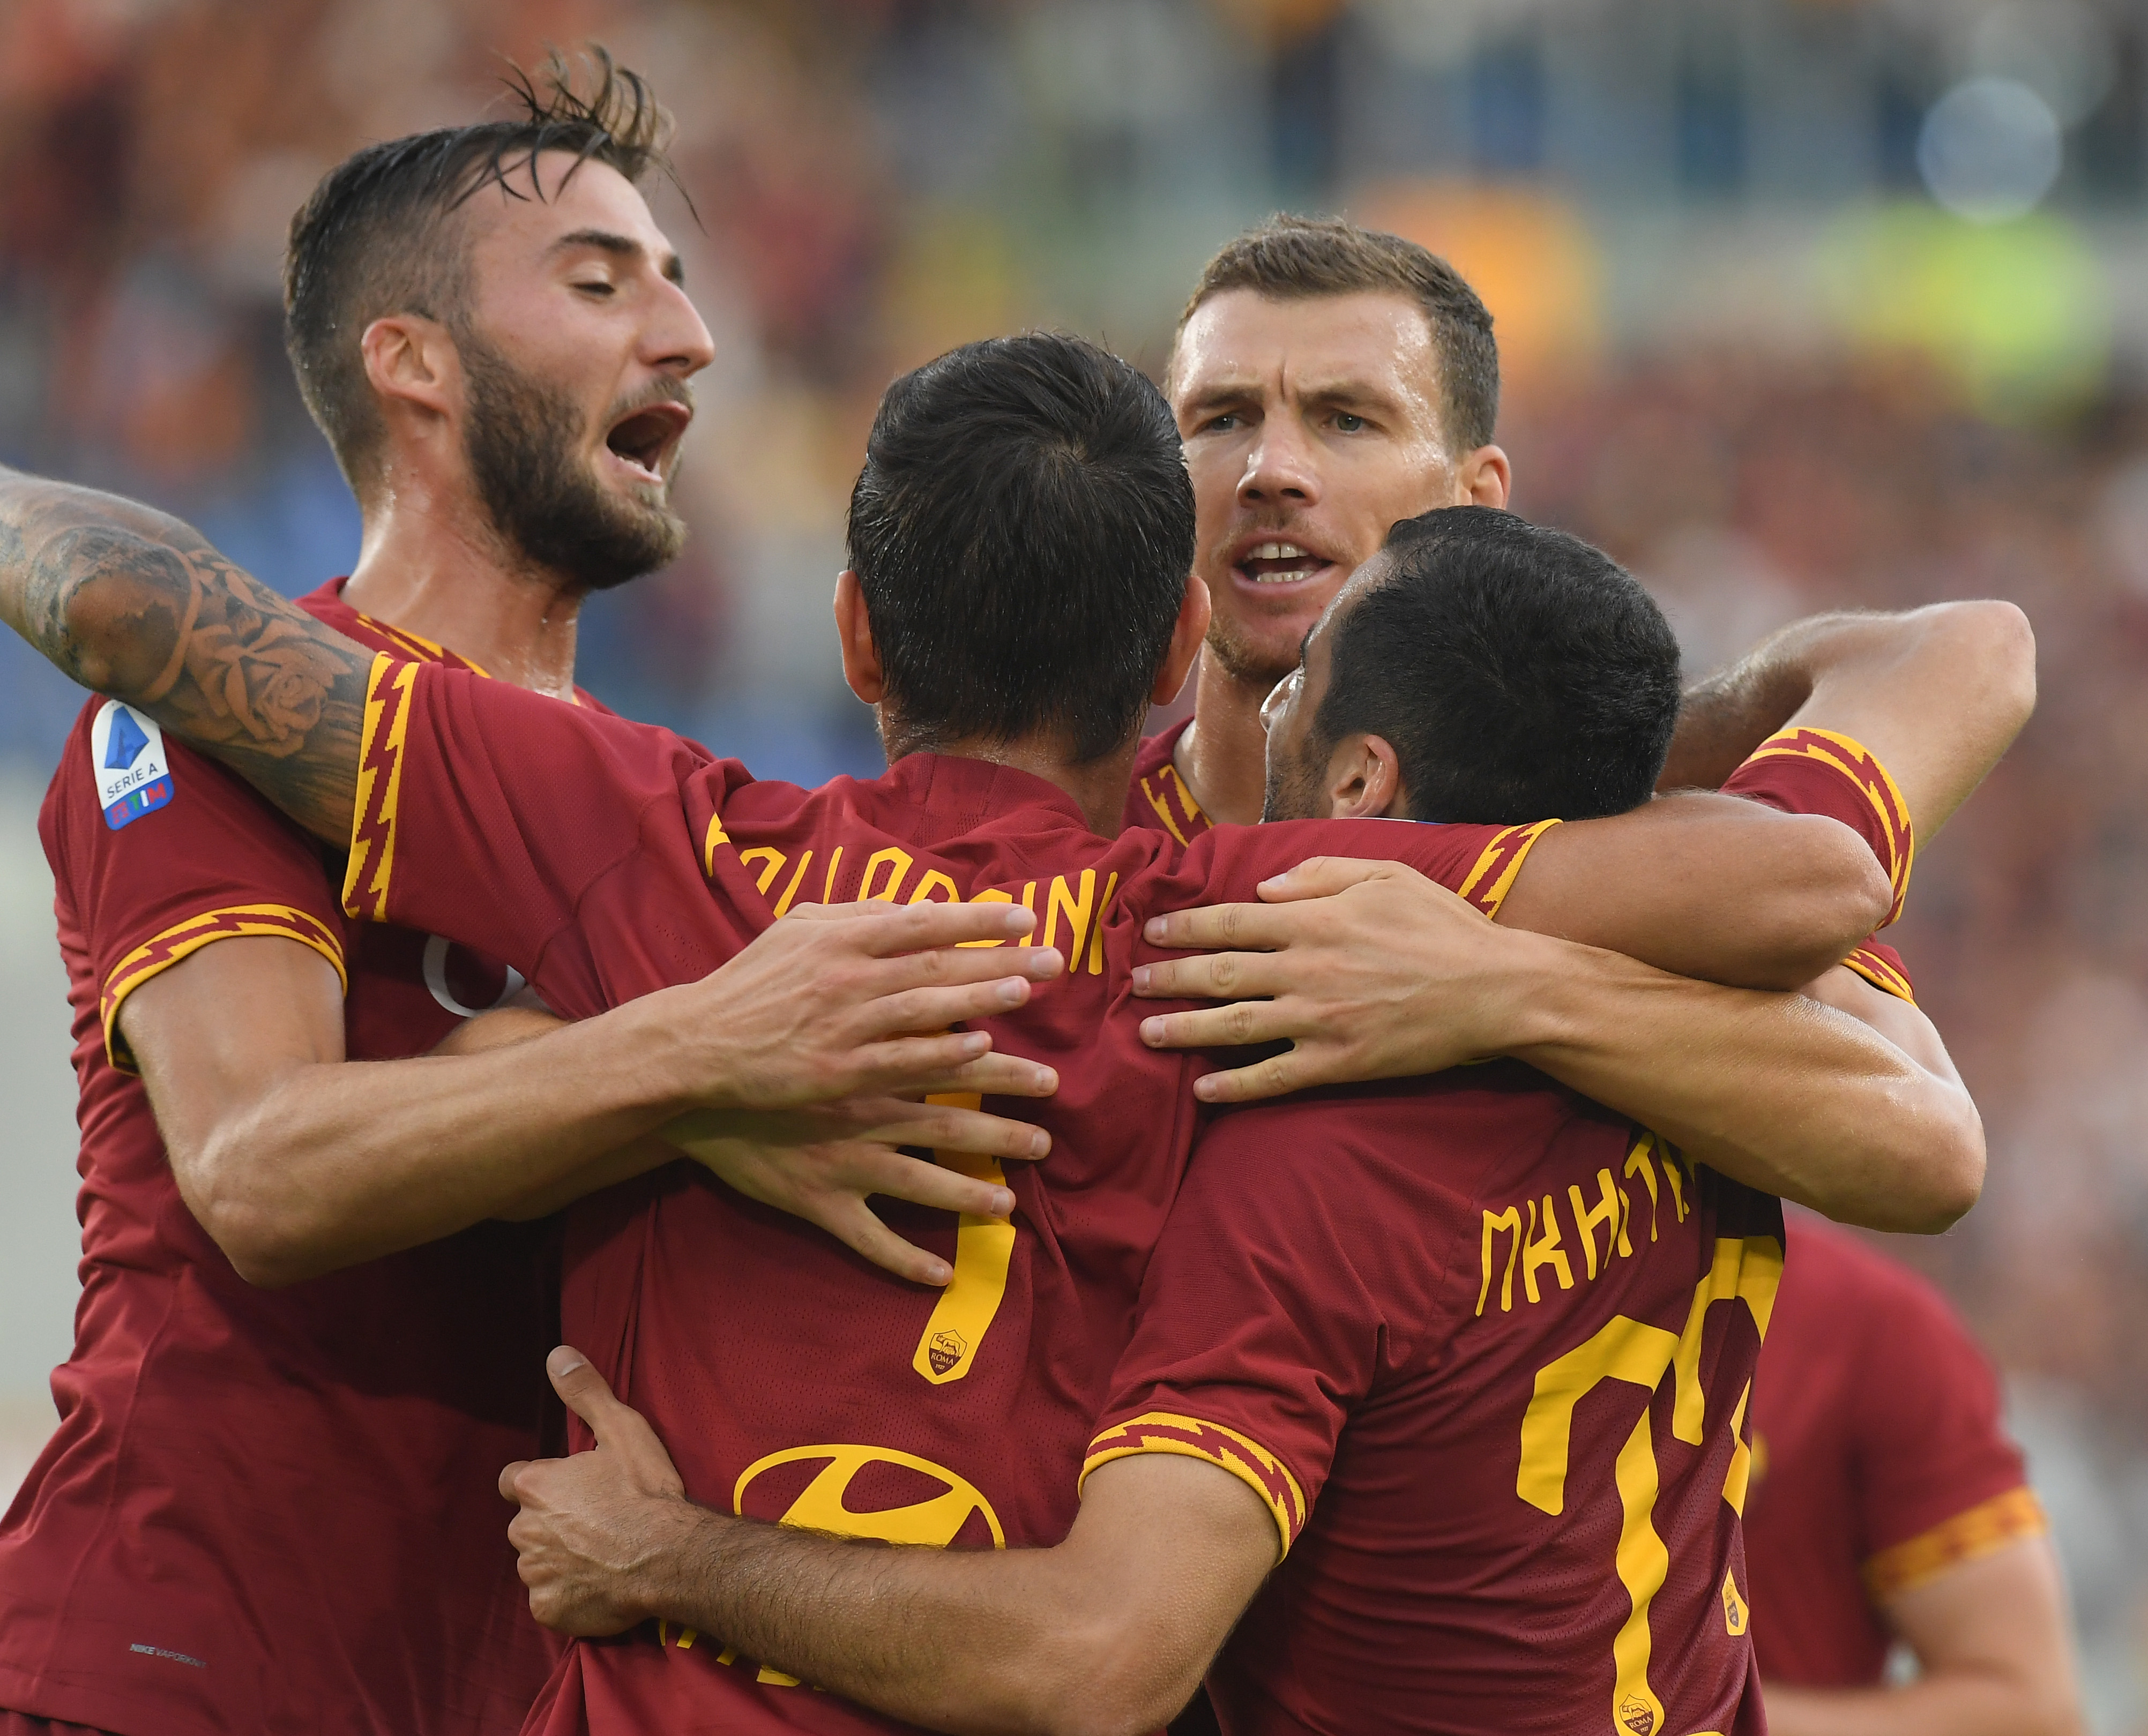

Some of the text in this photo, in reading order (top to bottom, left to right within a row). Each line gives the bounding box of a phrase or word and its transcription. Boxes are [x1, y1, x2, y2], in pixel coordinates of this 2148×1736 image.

[107, 763, 158, 798] SERIE A
[130, 783, 166, 810] TIM
[931, 1352, 953, 1365] ROMA
[130, 1643, 155, 1655] NIKE
[1629, 1716, 1652, 1728] ROMA
